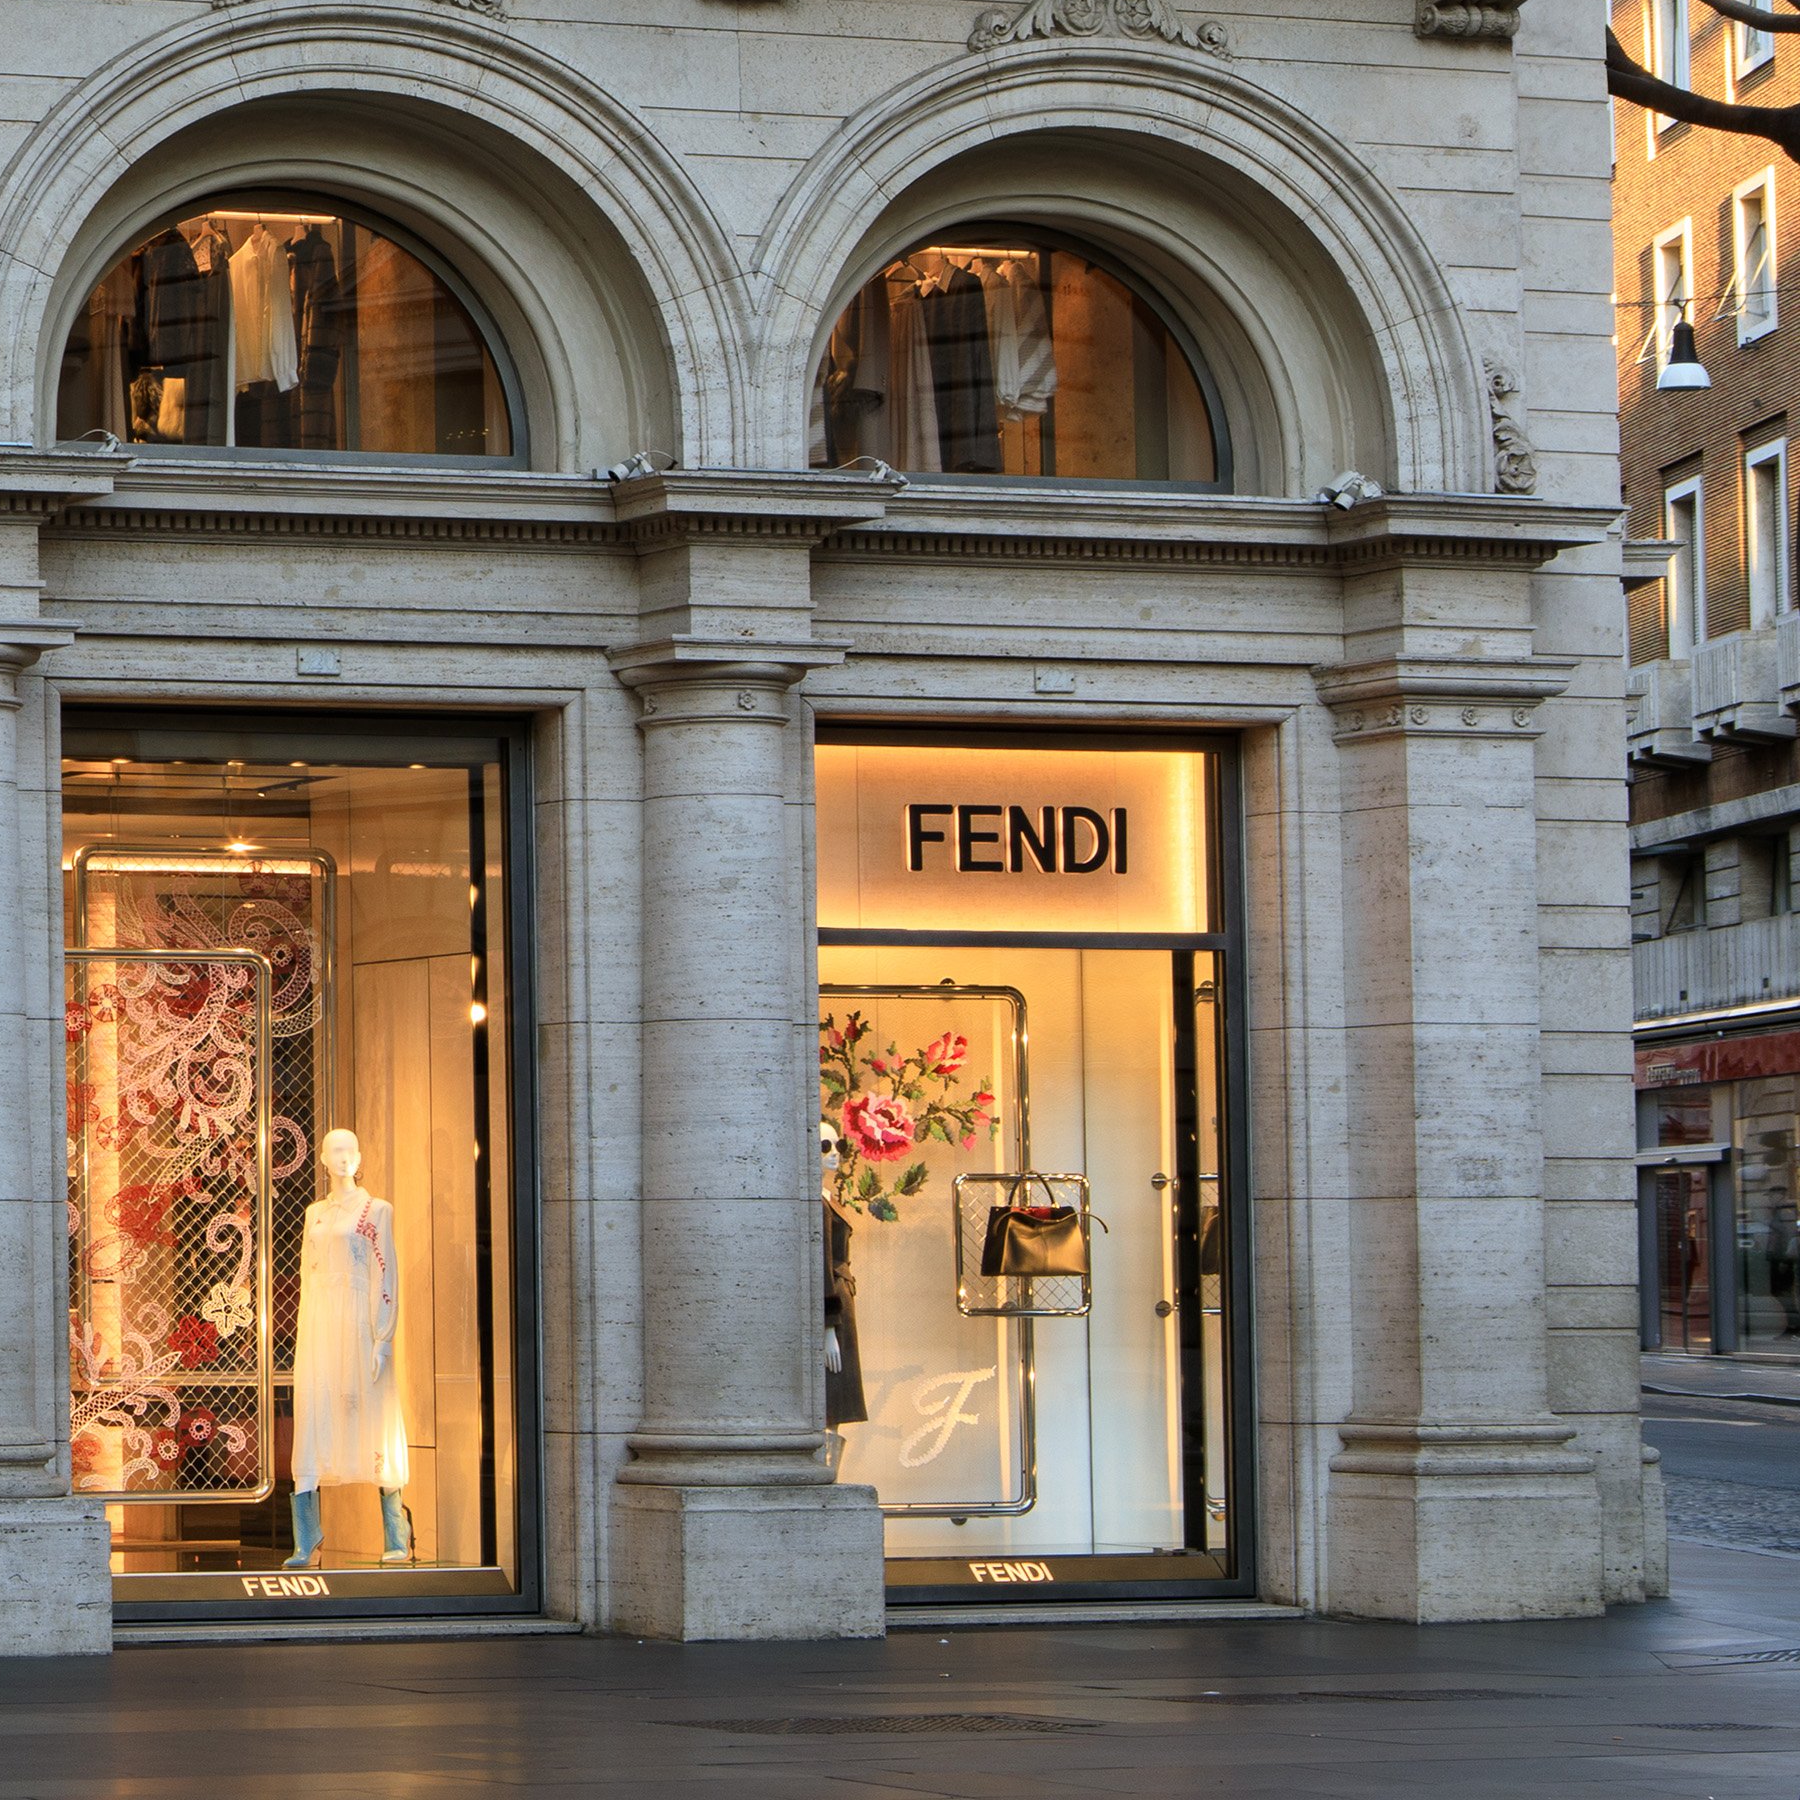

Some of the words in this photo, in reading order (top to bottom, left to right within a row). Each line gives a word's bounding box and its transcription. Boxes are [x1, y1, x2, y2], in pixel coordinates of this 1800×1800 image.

[905, 802, 1128, 876] FENDI
[968, 1561, 1055, 1584] FENDI
[240, 1574, 331, 1598] FENDI
